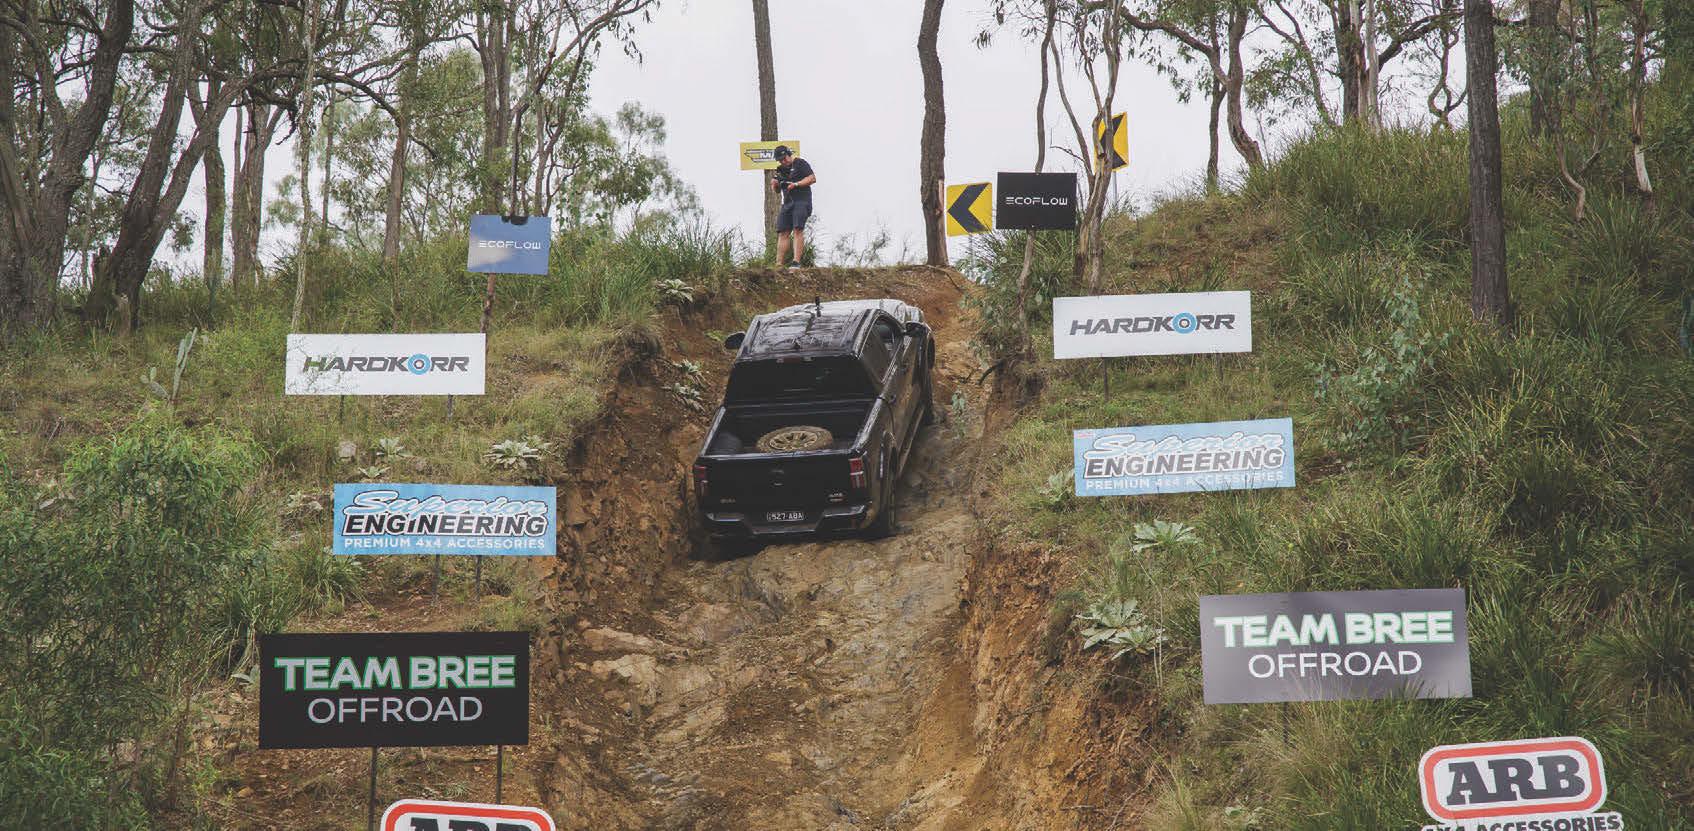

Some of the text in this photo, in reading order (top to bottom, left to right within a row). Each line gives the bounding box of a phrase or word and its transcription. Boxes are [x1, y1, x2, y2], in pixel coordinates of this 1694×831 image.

[1005, 195, 1068, 206] ECOFLOW
[478, 240, 542, 250] ECOFLOW
[1070, 312, 1235, 335] HARDKORR
[302, 353, 470, 376] HARDKORR
[1083, 432, 1284, 459] Superior
[1083, 449, 1286, 478] ENGINEERING
[1086, 478, 1150, 491] PREMIUM
[1186, 470, 1284, 487] ACCESSORIES
[344, 490, 548, 516] Superior
[344, 513, 547, 536] ENGINEERING
[344, 537, 410, 549] PREMIUM
[447, 538, 545, 550] ACCESSORIES
[1214, 610, 1455, 648] TEAM BREE
[273, 655, 516, 691] TEAM BREE
[1248, 650, 1422, 679] OFFROAD
[308, 696, 483, 724] OFFROAD
[1446, 754, 1586, 806] ARB
